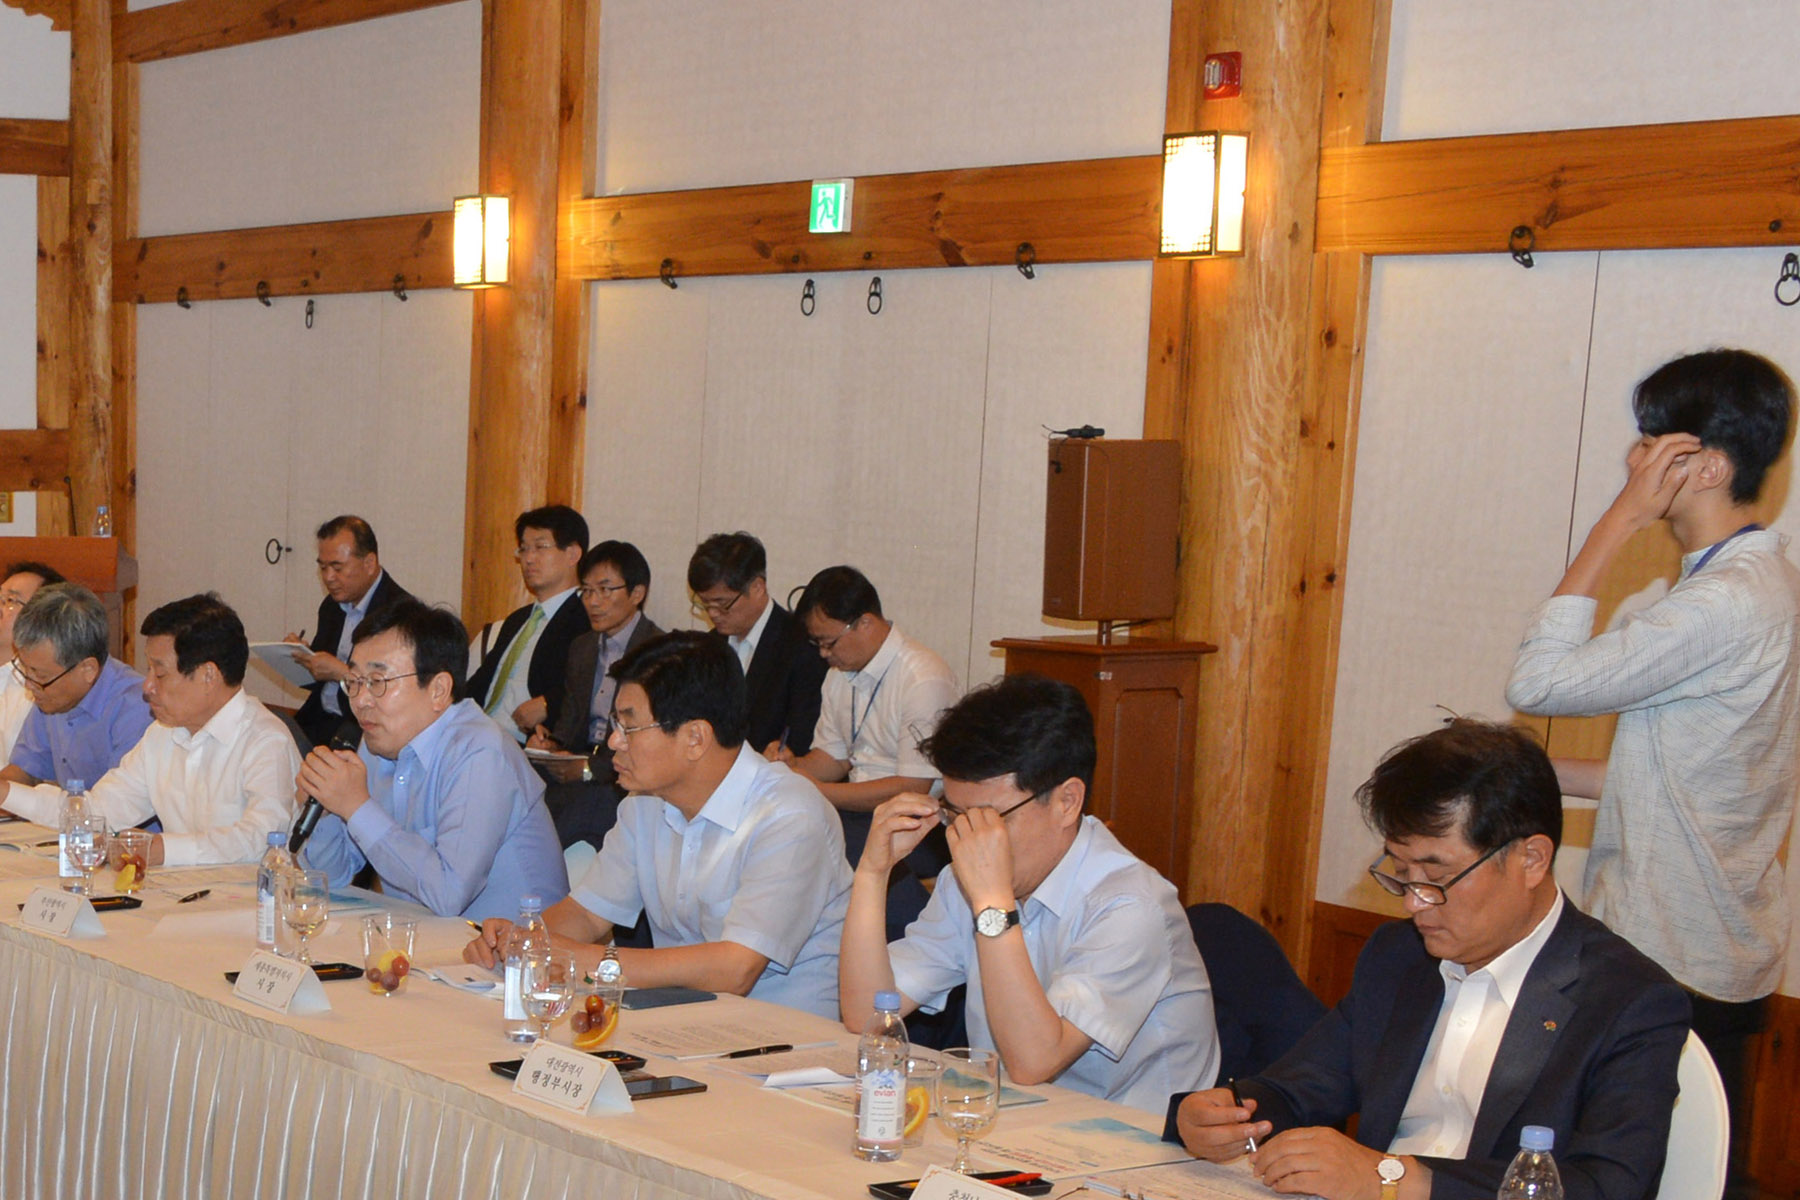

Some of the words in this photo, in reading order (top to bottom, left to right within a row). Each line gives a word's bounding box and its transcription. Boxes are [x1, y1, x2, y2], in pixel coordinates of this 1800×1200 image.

[546, 1057, 584, 1077] 대전광역시
[532, 1070, 582, 1098] 행정부시장
[874, 1089, 896, 1097] evian
